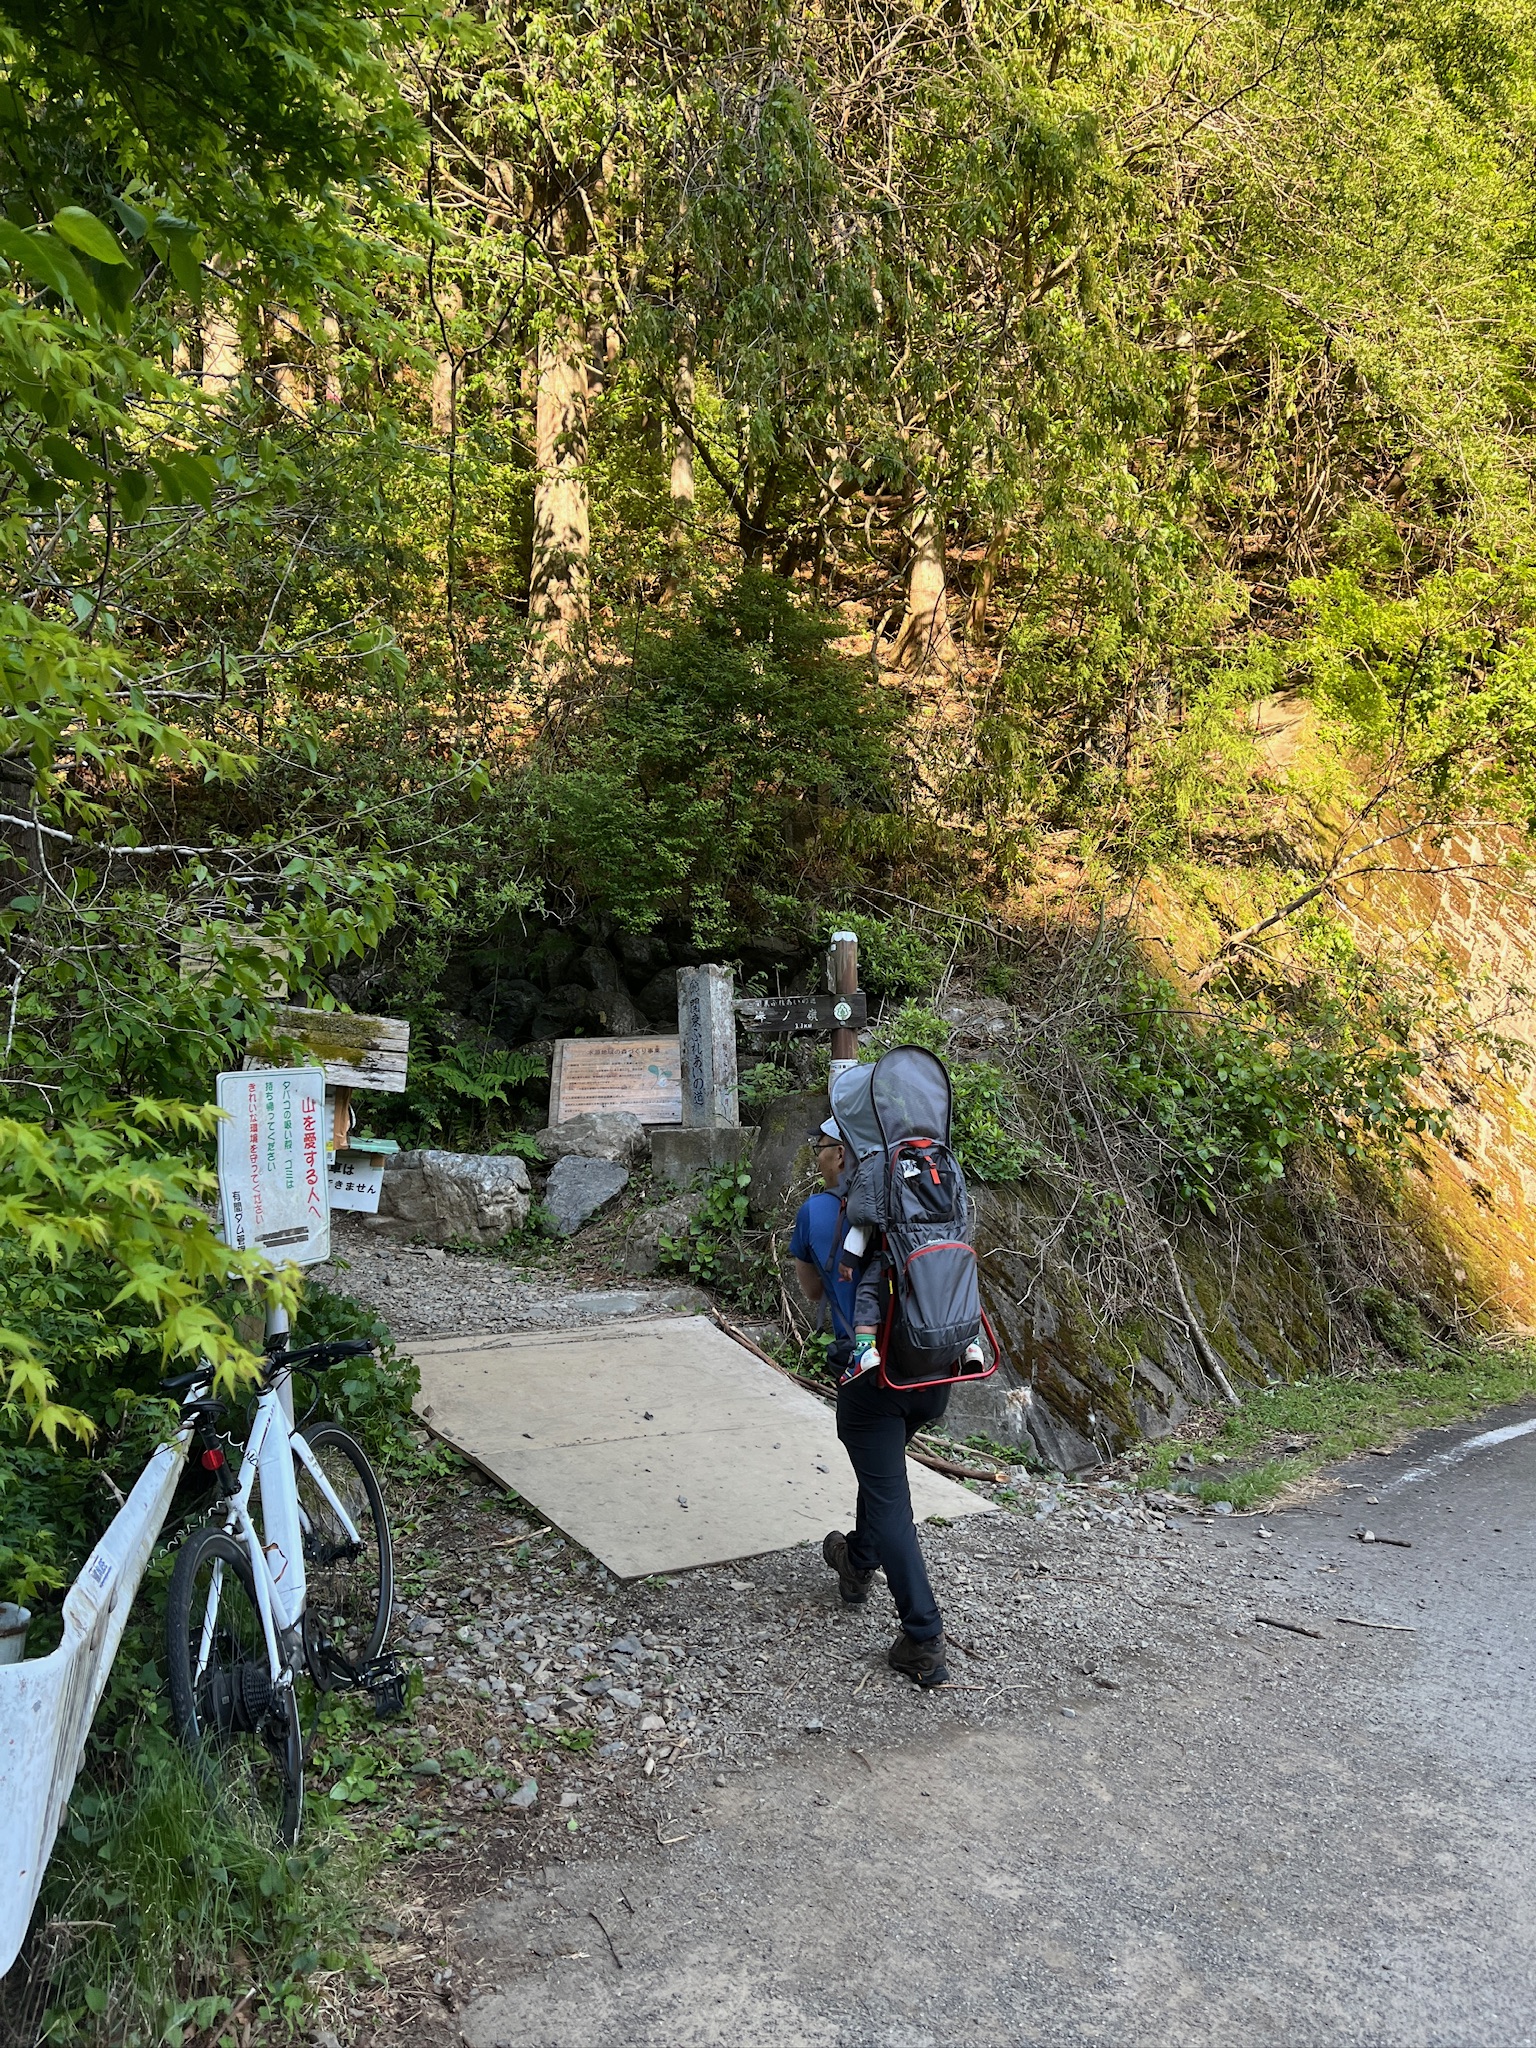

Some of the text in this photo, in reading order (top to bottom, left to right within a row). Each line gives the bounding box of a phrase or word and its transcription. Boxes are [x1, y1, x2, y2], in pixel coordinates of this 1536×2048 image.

[248, 1083, 264, 1225] きれいな環境を守ってください
[265, 1082, 276, 1172] 持ち帰ってください
[301, 1096, 322, 1219] 山を愛する人へ
